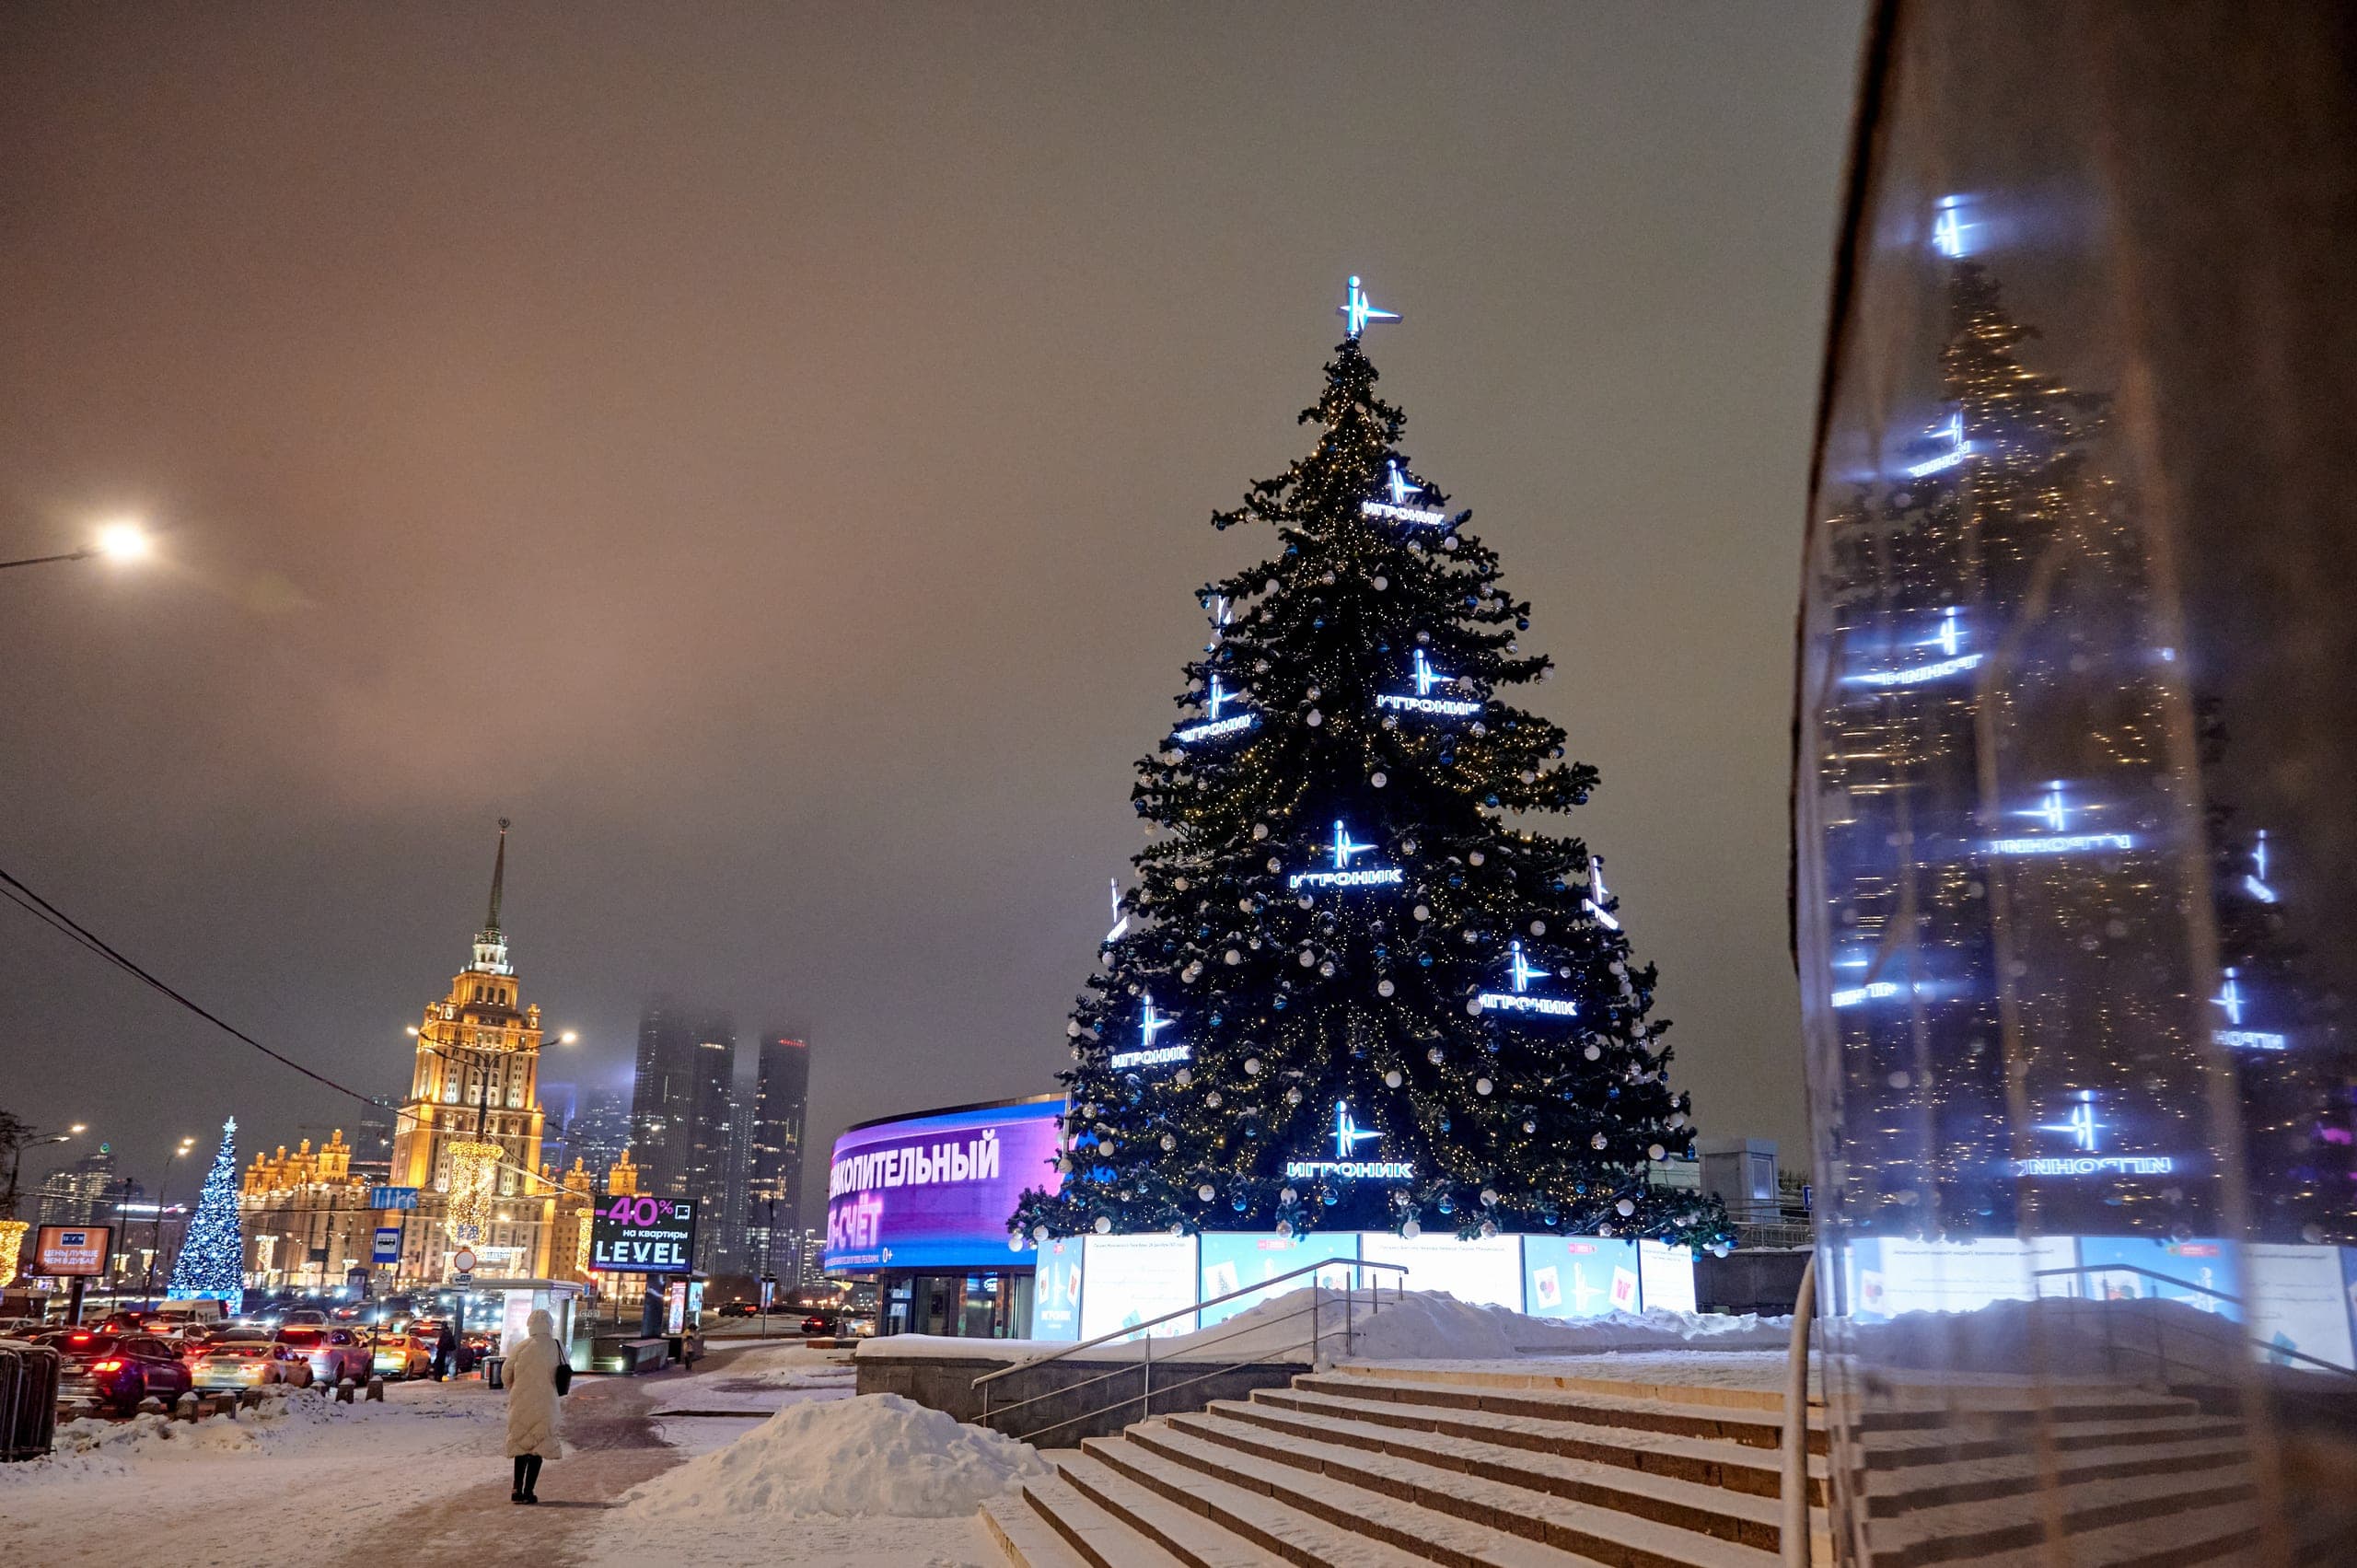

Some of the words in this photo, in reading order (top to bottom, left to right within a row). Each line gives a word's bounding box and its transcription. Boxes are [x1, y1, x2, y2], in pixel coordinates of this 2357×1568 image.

[1362, 501, 1445, 525] ИГРОНИК
[1111, 1045, 1190, 1068] ИГРОНИК
[1286, 1161, 1414, 1179] ИГРОНИК
[596, 1197, 674, 1226] -40%
[622, 1229, 636, 1238] на
[638, 1229, 689, 1241] квартиры
[596, 1240, 686, 1264] LEVEL
[882, 1247, 893, 1263] 0+
